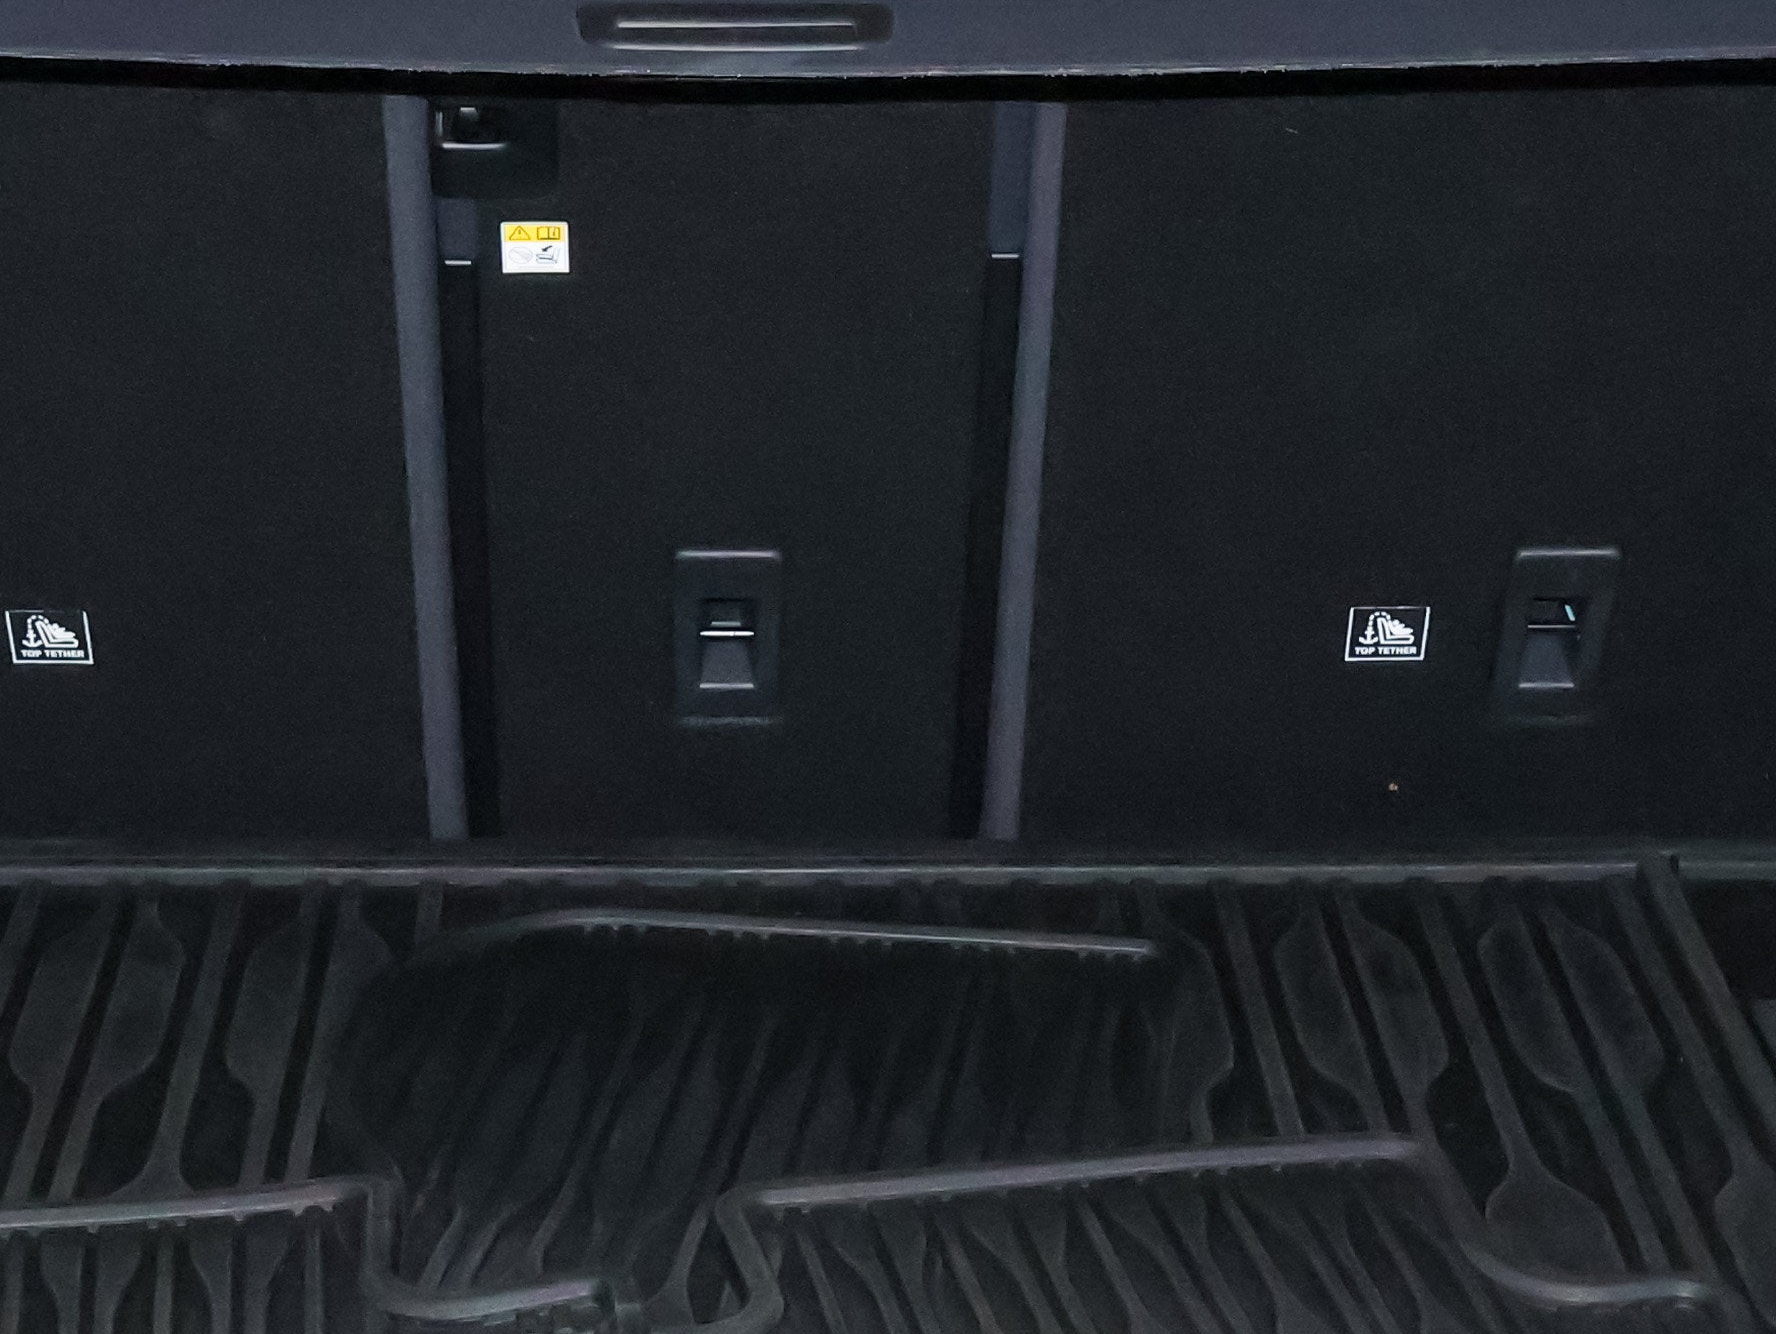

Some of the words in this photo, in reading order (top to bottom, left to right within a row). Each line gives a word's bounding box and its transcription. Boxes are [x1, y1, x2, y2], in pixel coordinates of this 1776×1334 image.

[21, 650, 42, 658] TOP
[44, 649, 85, 658] TETHER
[1355, 647, 1375, 655] TOP
[1377, 646, 1417, 655] TETHER
